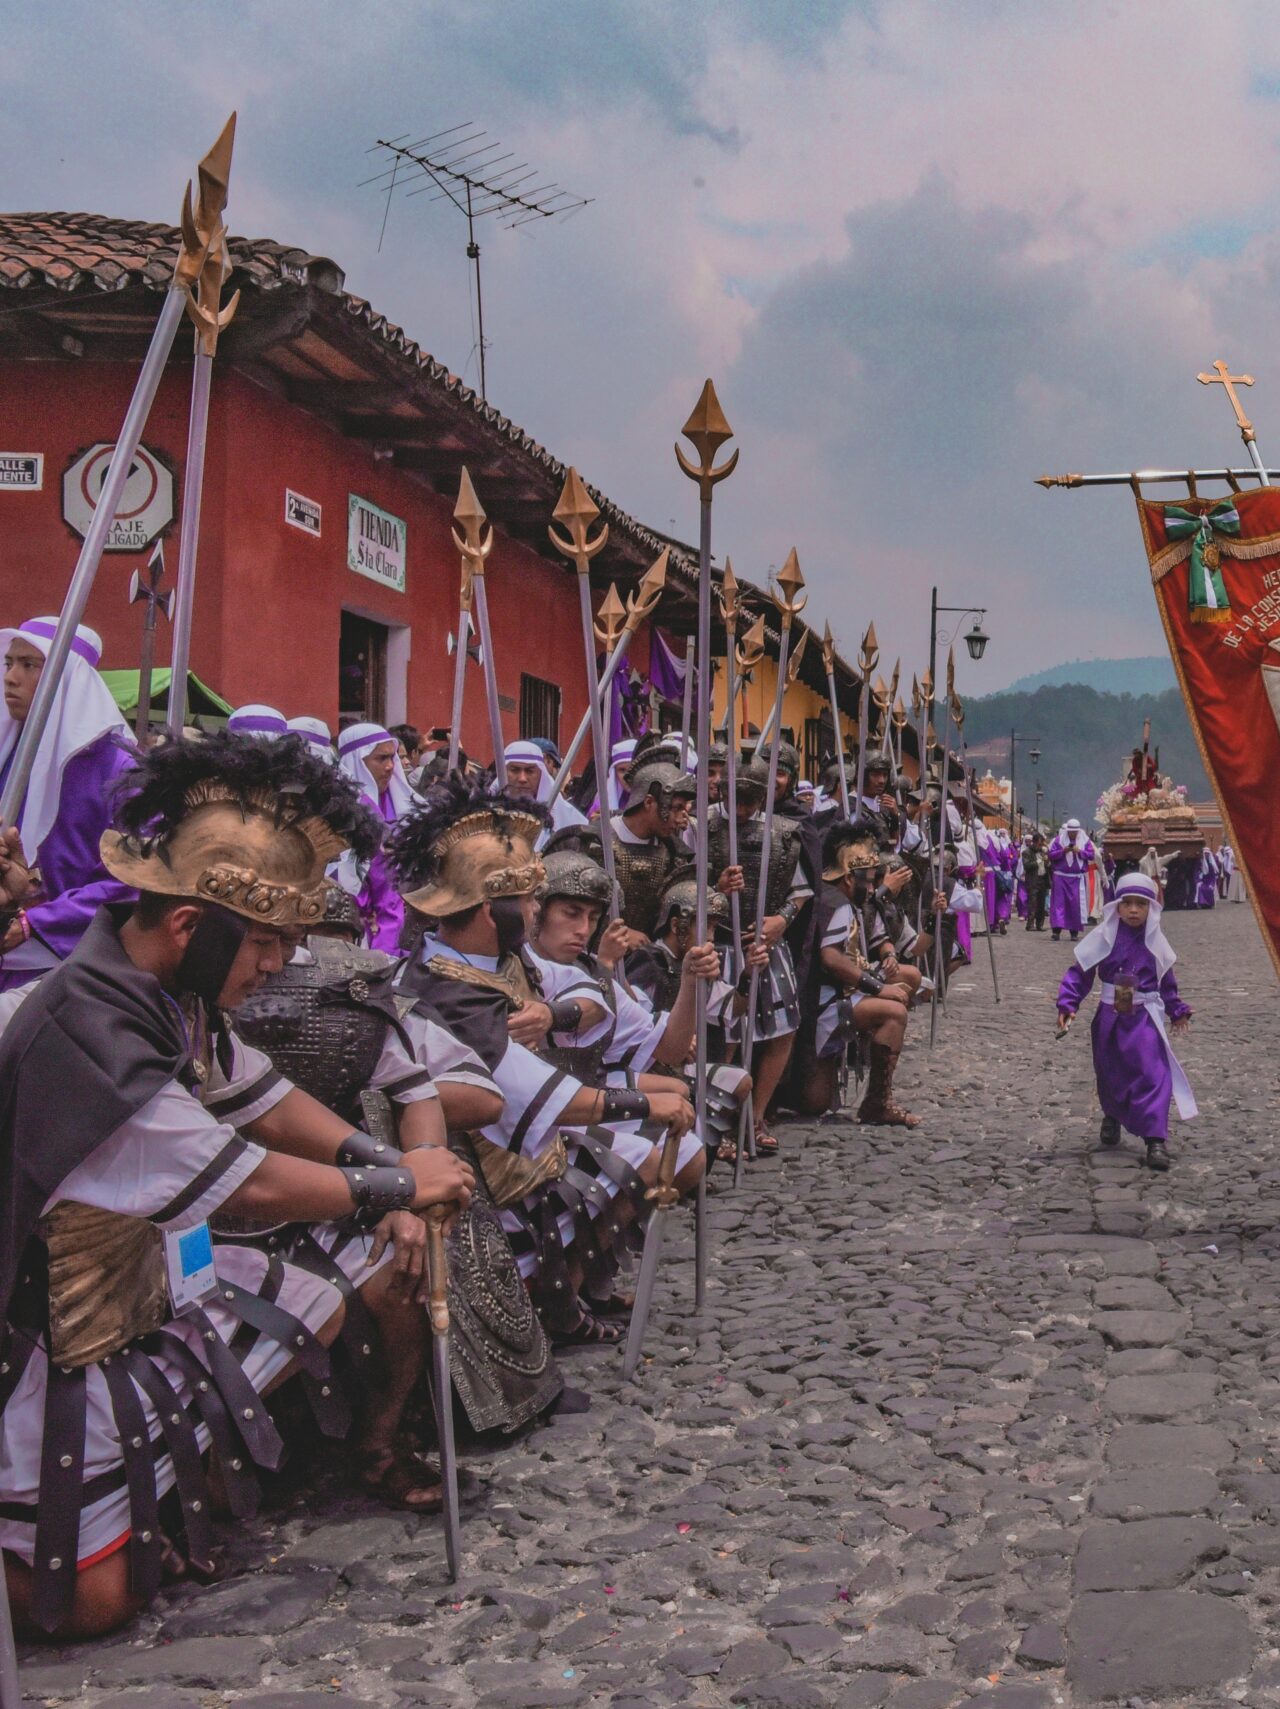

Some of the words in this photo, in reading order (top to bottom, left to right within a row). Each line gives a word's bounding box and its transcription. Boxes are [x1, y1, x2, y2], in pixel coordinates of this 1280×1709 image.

[0, 460, 25, 471] ALLE
[359, 506, 399, 553] TIENDA
[375, 550, 398, 580] Clara
[1222, 630, 1243, 649] DE
[1235, 615, 1255, 633] LA
